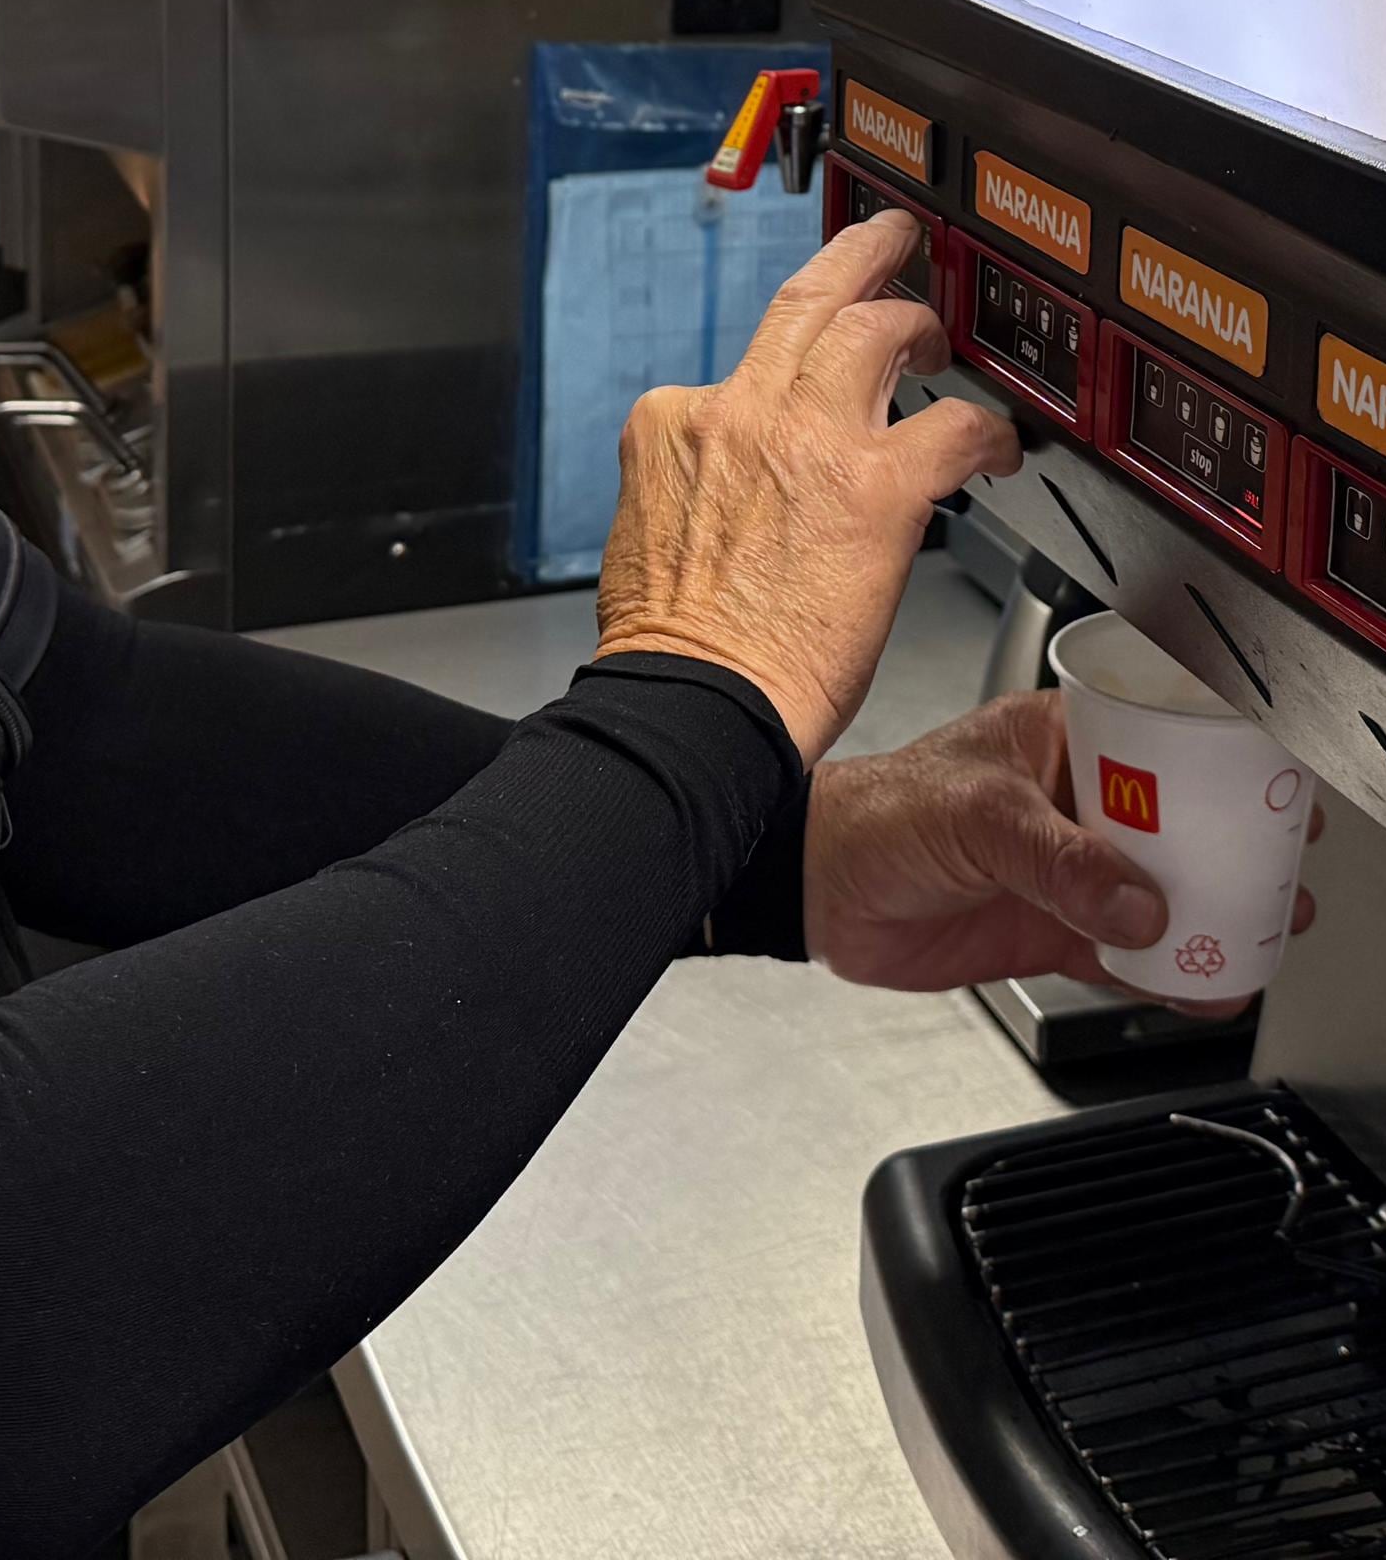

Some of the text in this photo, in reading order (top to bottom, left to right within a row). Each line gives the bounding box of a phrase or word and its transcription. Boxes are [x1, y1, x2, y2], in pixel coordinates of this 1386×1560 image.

[985, 170, 1081, 255] NARANJA
[1131, 252, 1253, 355] NARANJA
[1020, 340, 1039, 366] stop
[1190, 448, 1213, 477] stop
